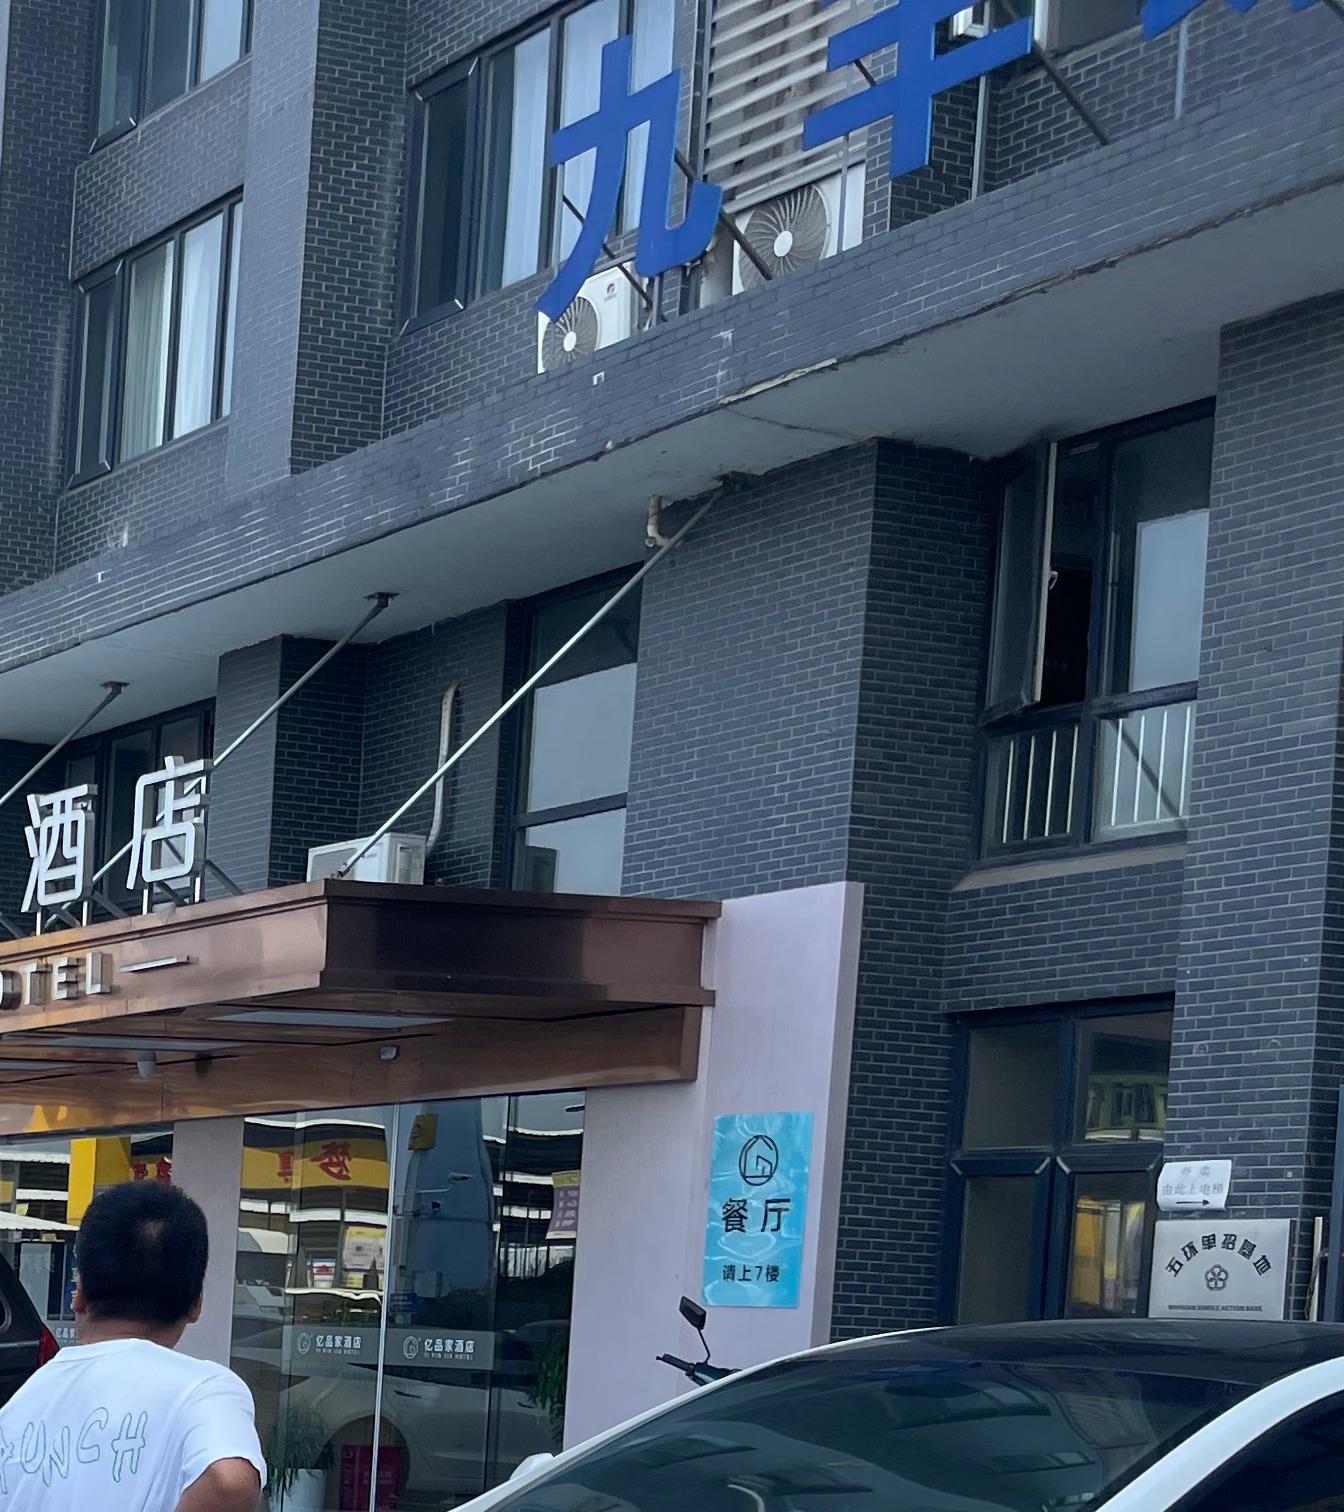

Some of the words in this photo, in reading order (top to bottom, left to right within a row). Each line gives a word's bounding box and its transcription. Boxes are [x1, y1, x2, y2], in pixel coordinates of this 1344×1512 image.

[722, 1198, 791, 1233] 餐厅
[723, 1264, 780, 1282] 请上7楼
[315, 1335, 362, 1349] 亿品家酒店
[424, 1338, 475, 1353] 亿品家酒店
